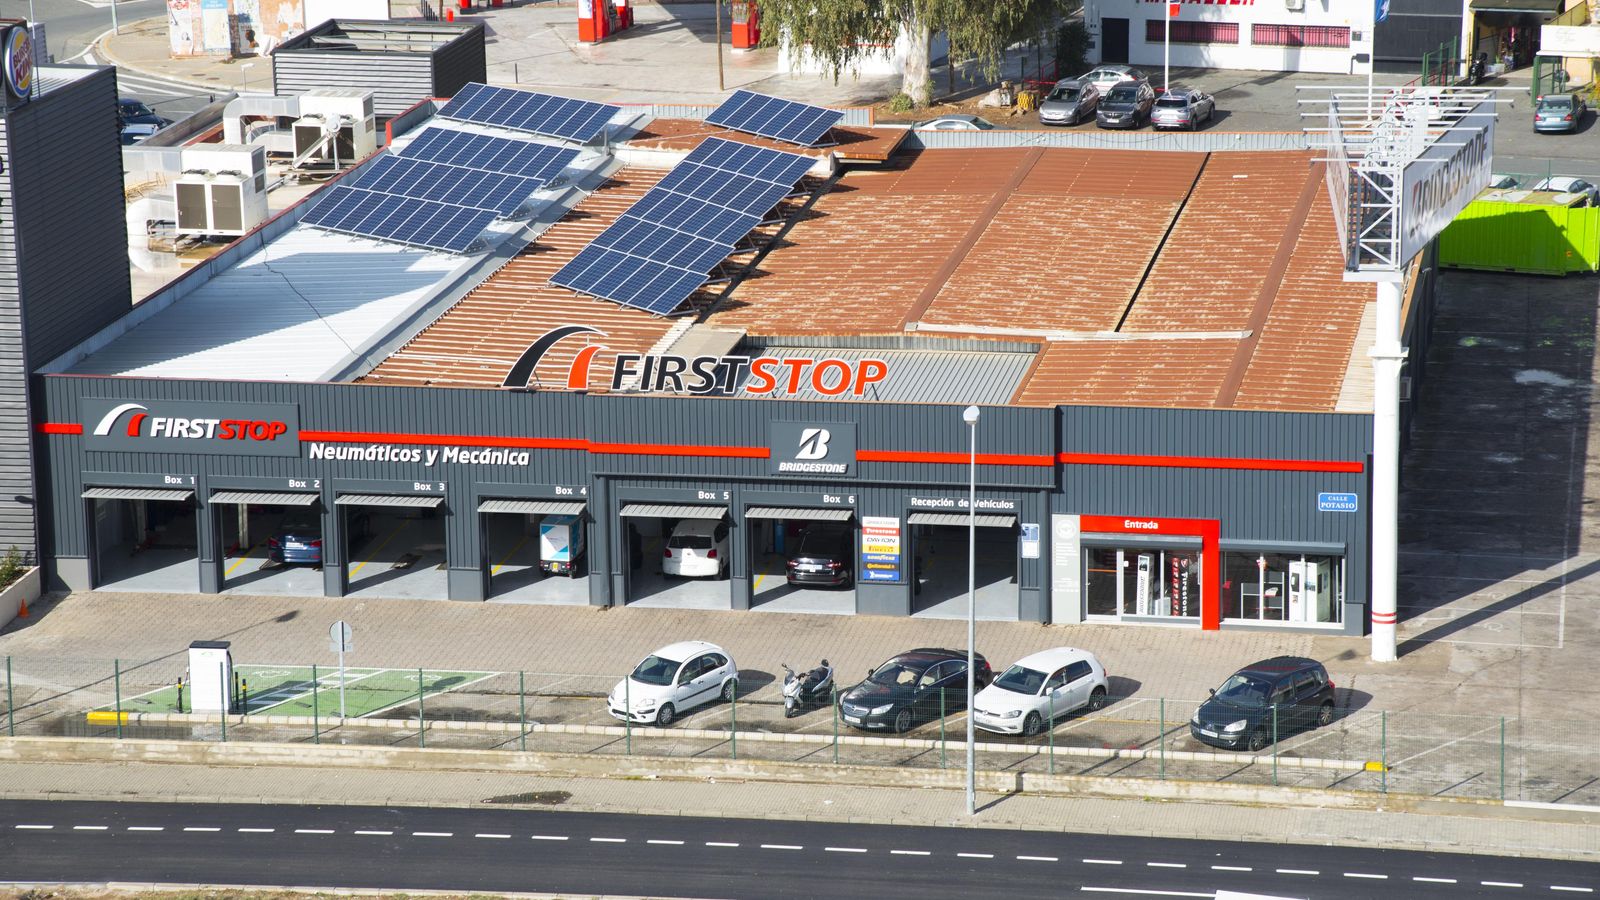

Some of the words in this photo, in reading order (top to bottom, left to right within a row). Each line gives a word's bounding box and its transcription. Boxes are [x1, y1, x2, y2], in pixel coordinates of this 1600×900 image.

[309, 442, 421, 462] Neumáticos
[425, 450, 438, 467] y
[443, 446, 529, 466] Mecánica
[778, 462, 848, 474] BRIDGESTONE
[164, 476, 182, 484] Box
[288, 480, 306, 488] Box
[314, 480, 320, 488] 2
[414, 482, 431, 491] Box
[439, 483, 445, 492] 3
[556, 486, 572, 494] Box
[580, 487, 587, 495] 4
[698, 490, 716, 499] Box
[723, 491, 730, 500] 5
[823, 494, 840, 504] Box
[848, 495, 855, 504] 6
[911, 497, 954, 509] Recepción
[958, 498, 969, 508] de
[1124, 519, 1159, 529] Entrada
[1181, 571, 1189, 616] Firestone
